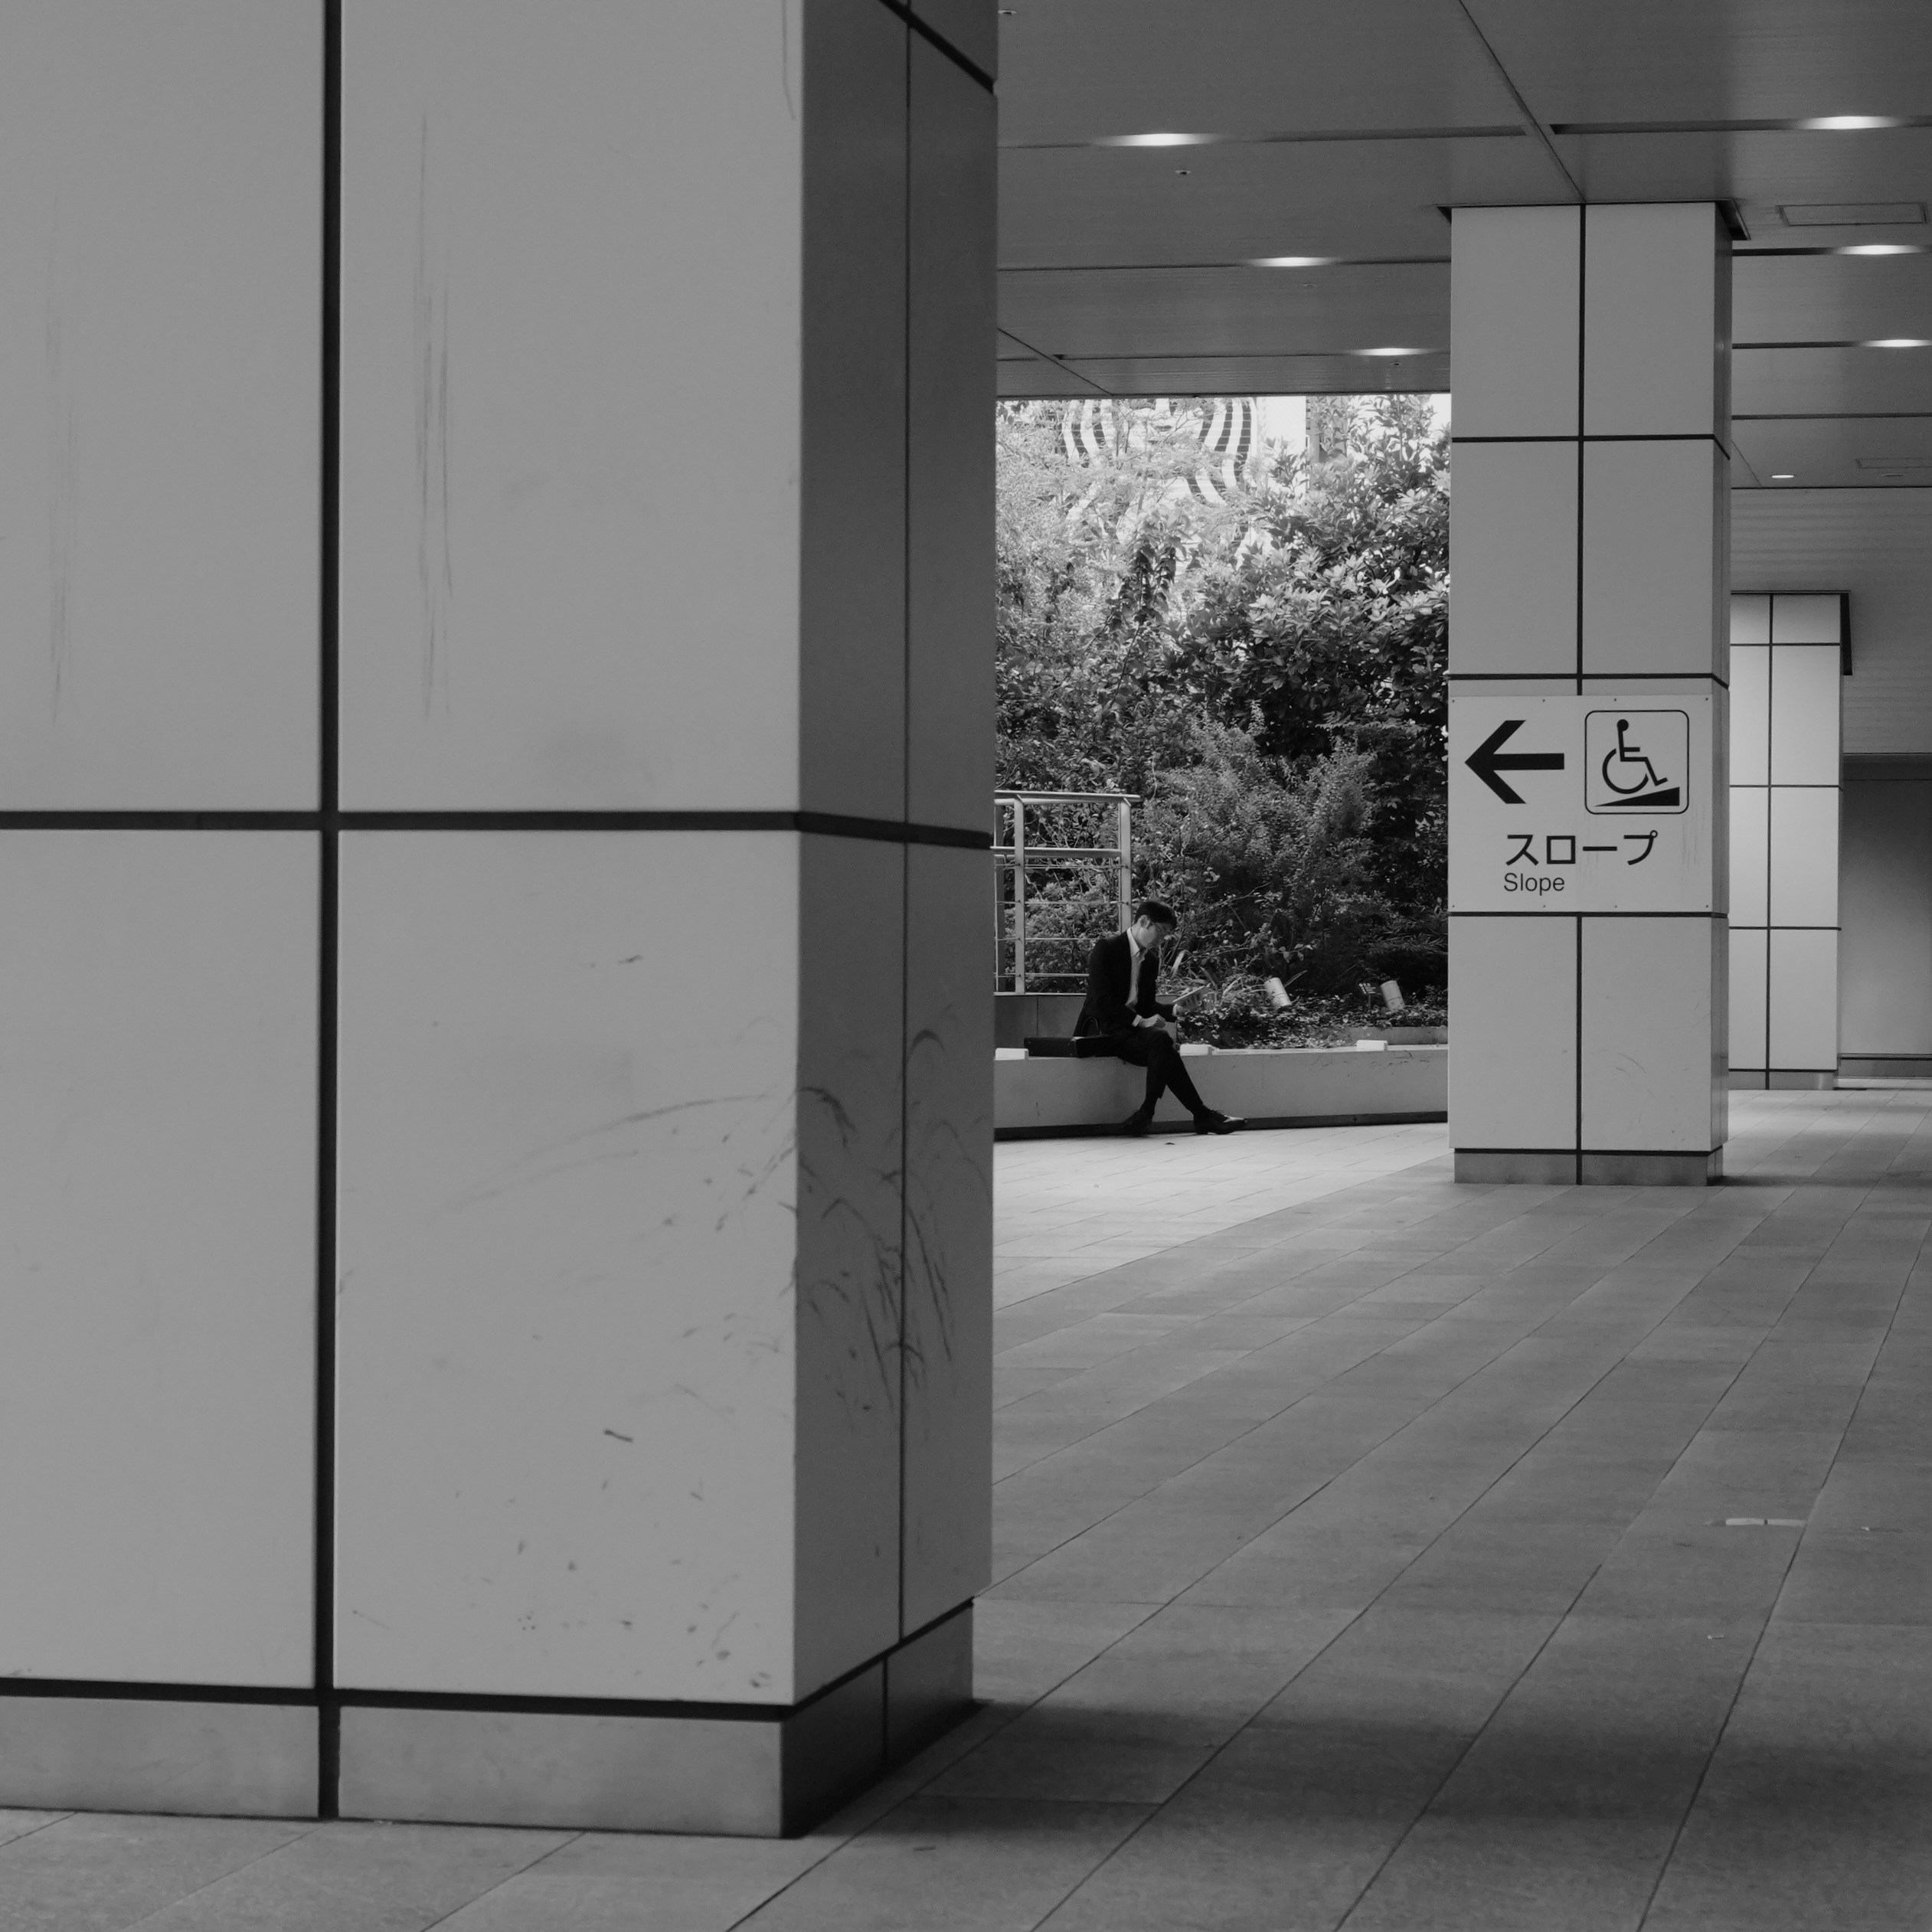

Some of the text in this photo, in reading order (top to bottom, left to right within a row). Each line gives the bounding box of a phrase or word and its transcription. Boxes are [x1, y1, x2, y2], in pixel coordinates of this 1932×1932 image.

[1505, 830, 1659, 866] スロープ
[1503, 872, 1565, 896] Slope
